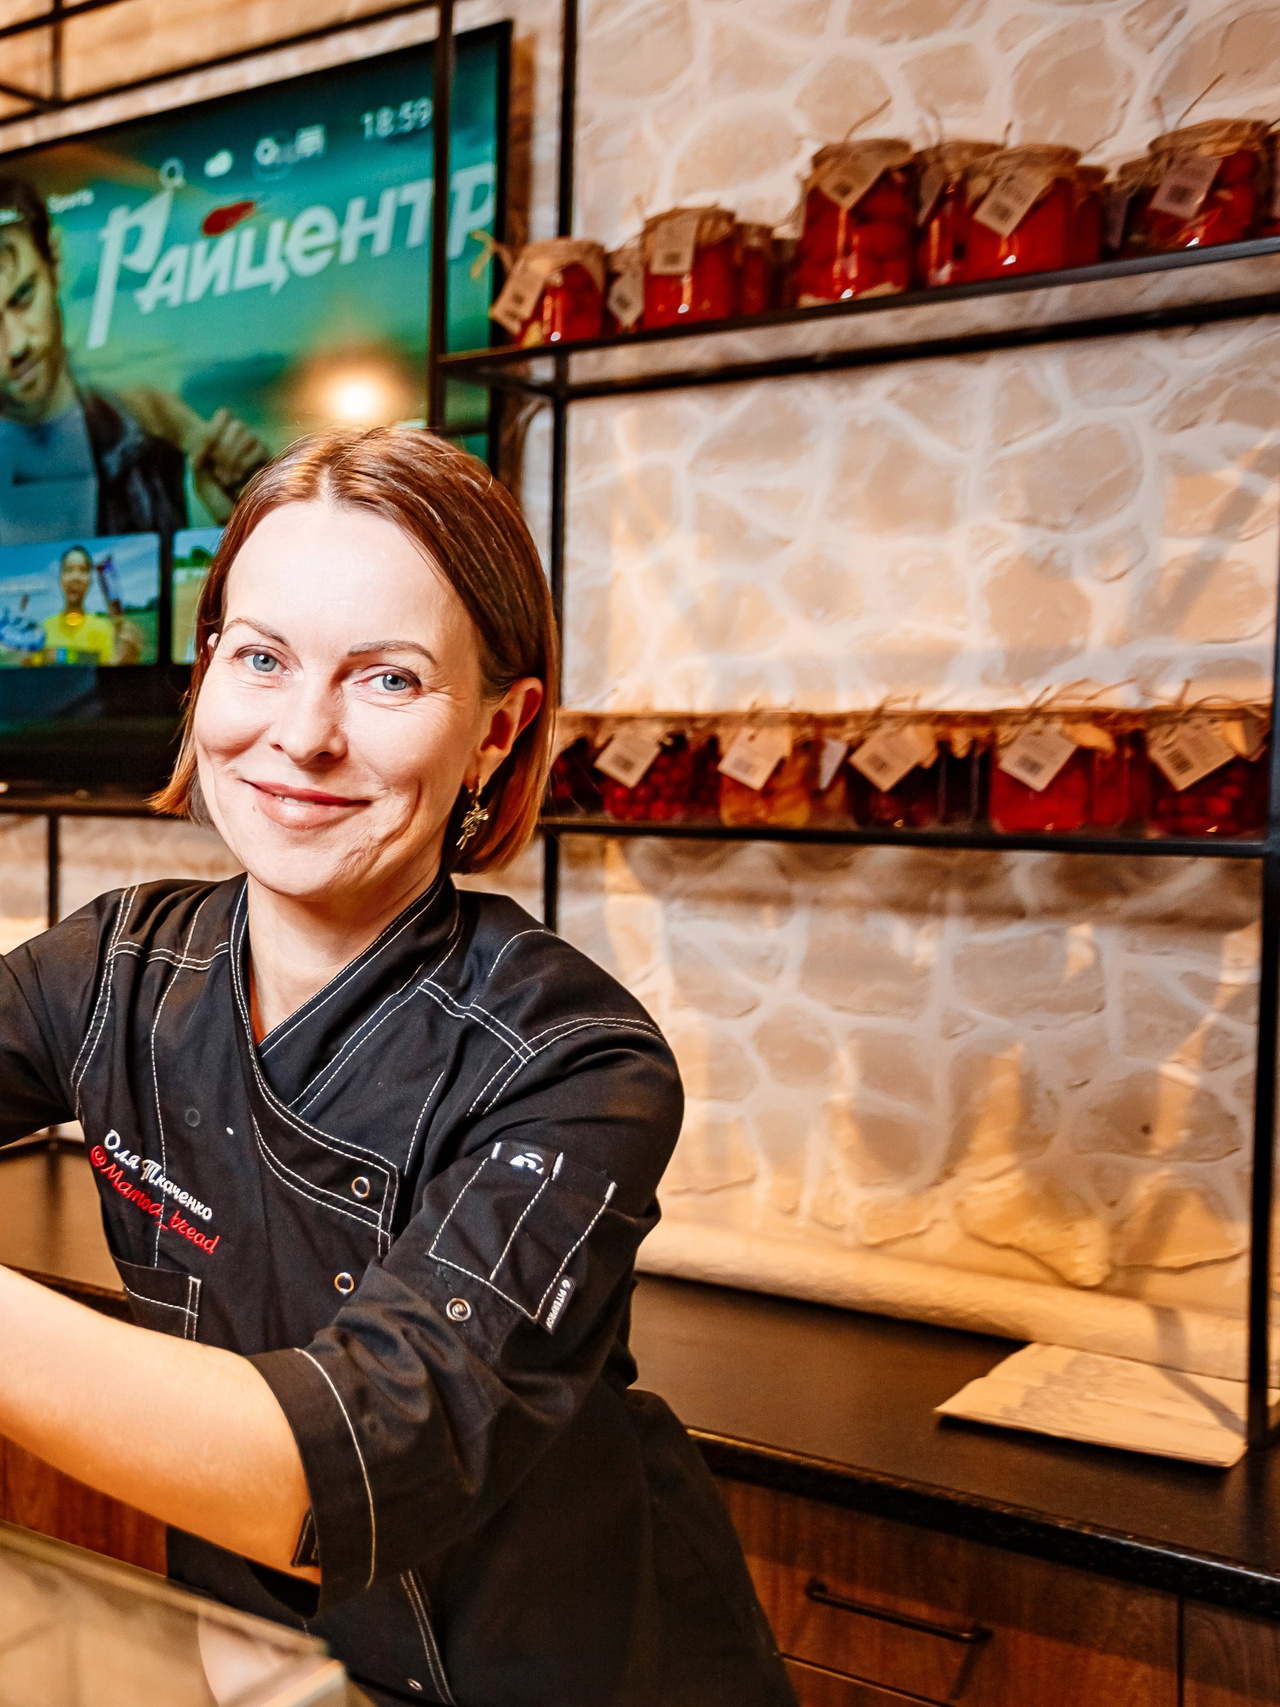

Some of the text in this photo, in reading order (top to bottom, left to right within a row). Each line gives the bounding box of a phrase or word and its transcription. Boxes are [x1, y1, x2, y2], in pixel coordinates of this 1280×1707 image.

[362, 97, 433, 139] 18:59
[104, 1129, 213, 1221] Оля Ткаченко
